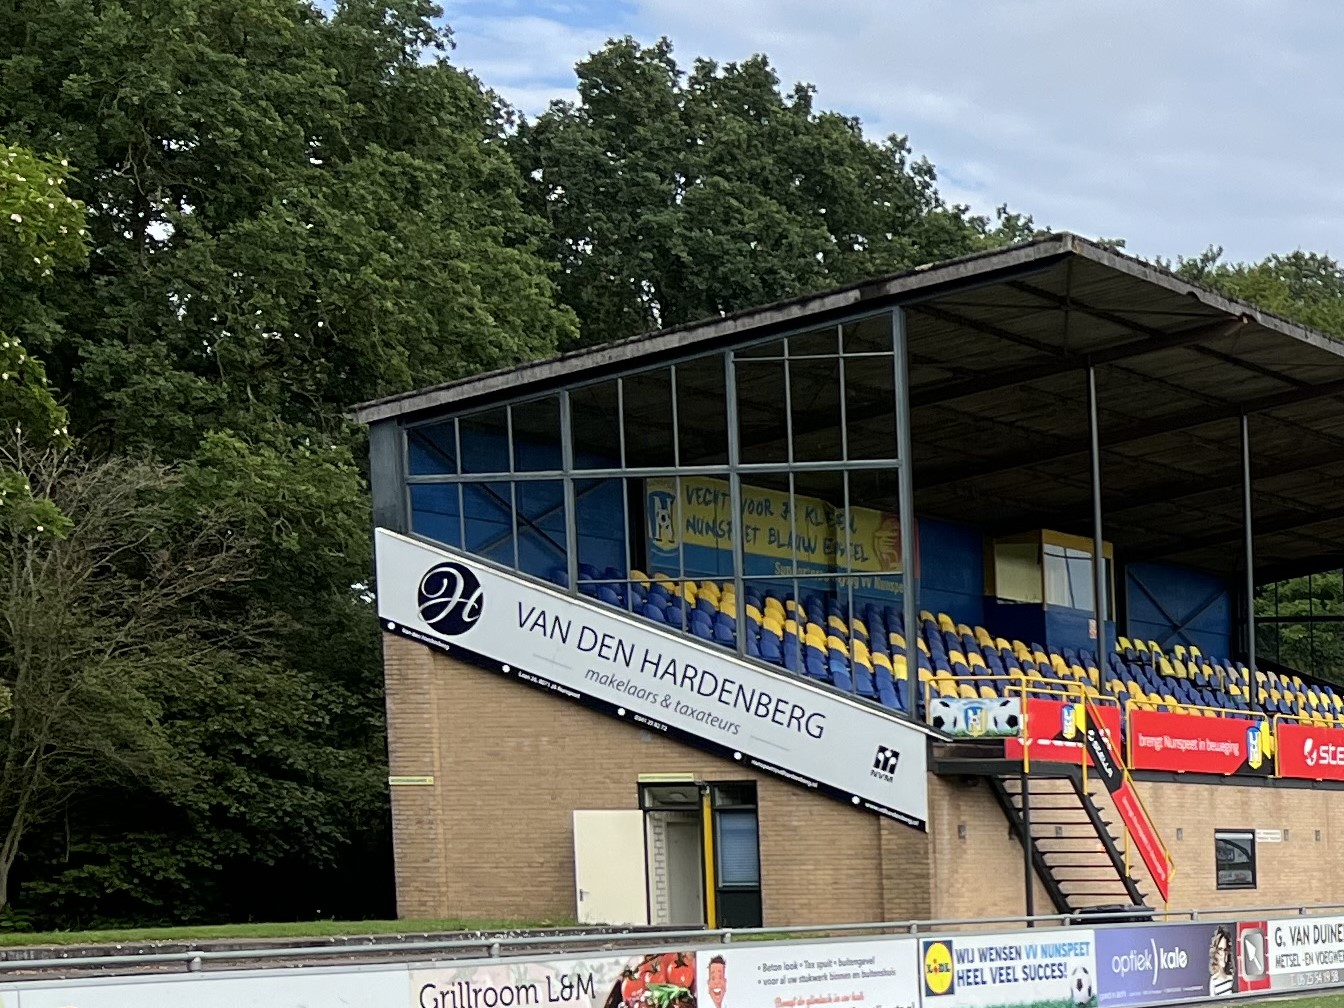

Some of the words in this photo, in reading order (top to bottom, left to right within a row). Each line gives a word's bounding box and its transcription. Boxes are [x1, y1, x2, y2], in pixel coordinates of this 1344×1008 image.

[686, 515, 760, 545] NUNSPET
[517, 601, 573, 644] VAN
[577, 625, 636, 668] DEN
[640, 648, 827, 740] HARDENBERG
[585, 667, 658, 705] makelaars
[660, 695, 672, 709] &
[674, 701, 741, 735] taxateurs
[1137, 733, 1163, 749] brengt
[1163, 735, 1197, 752] Nunspeet
[1206, 740, 1240, 757] beweging
[1275, 927, 1286, 948] G.
[1289, 926, 1310, 946] VAN
[955, 948, 975, 965] WIJ
[978, 945, 1022, 963] WENSEN
[1025, 943, 1038, 960] VV
[1041, 942, 1090, 959] NUNSPEET
[1111, 949, 1152, 977] optiek
[1159, 947, 1188, 969] kale
[1276, 953, 1301, 968] METSEL
[546, 973, 596, 1003] L&M
[956, 967, 987, 987] HEEL
[991, 964, 1019, 985] VEEL
[1022, 962, 1067, 982] SUCCES!
